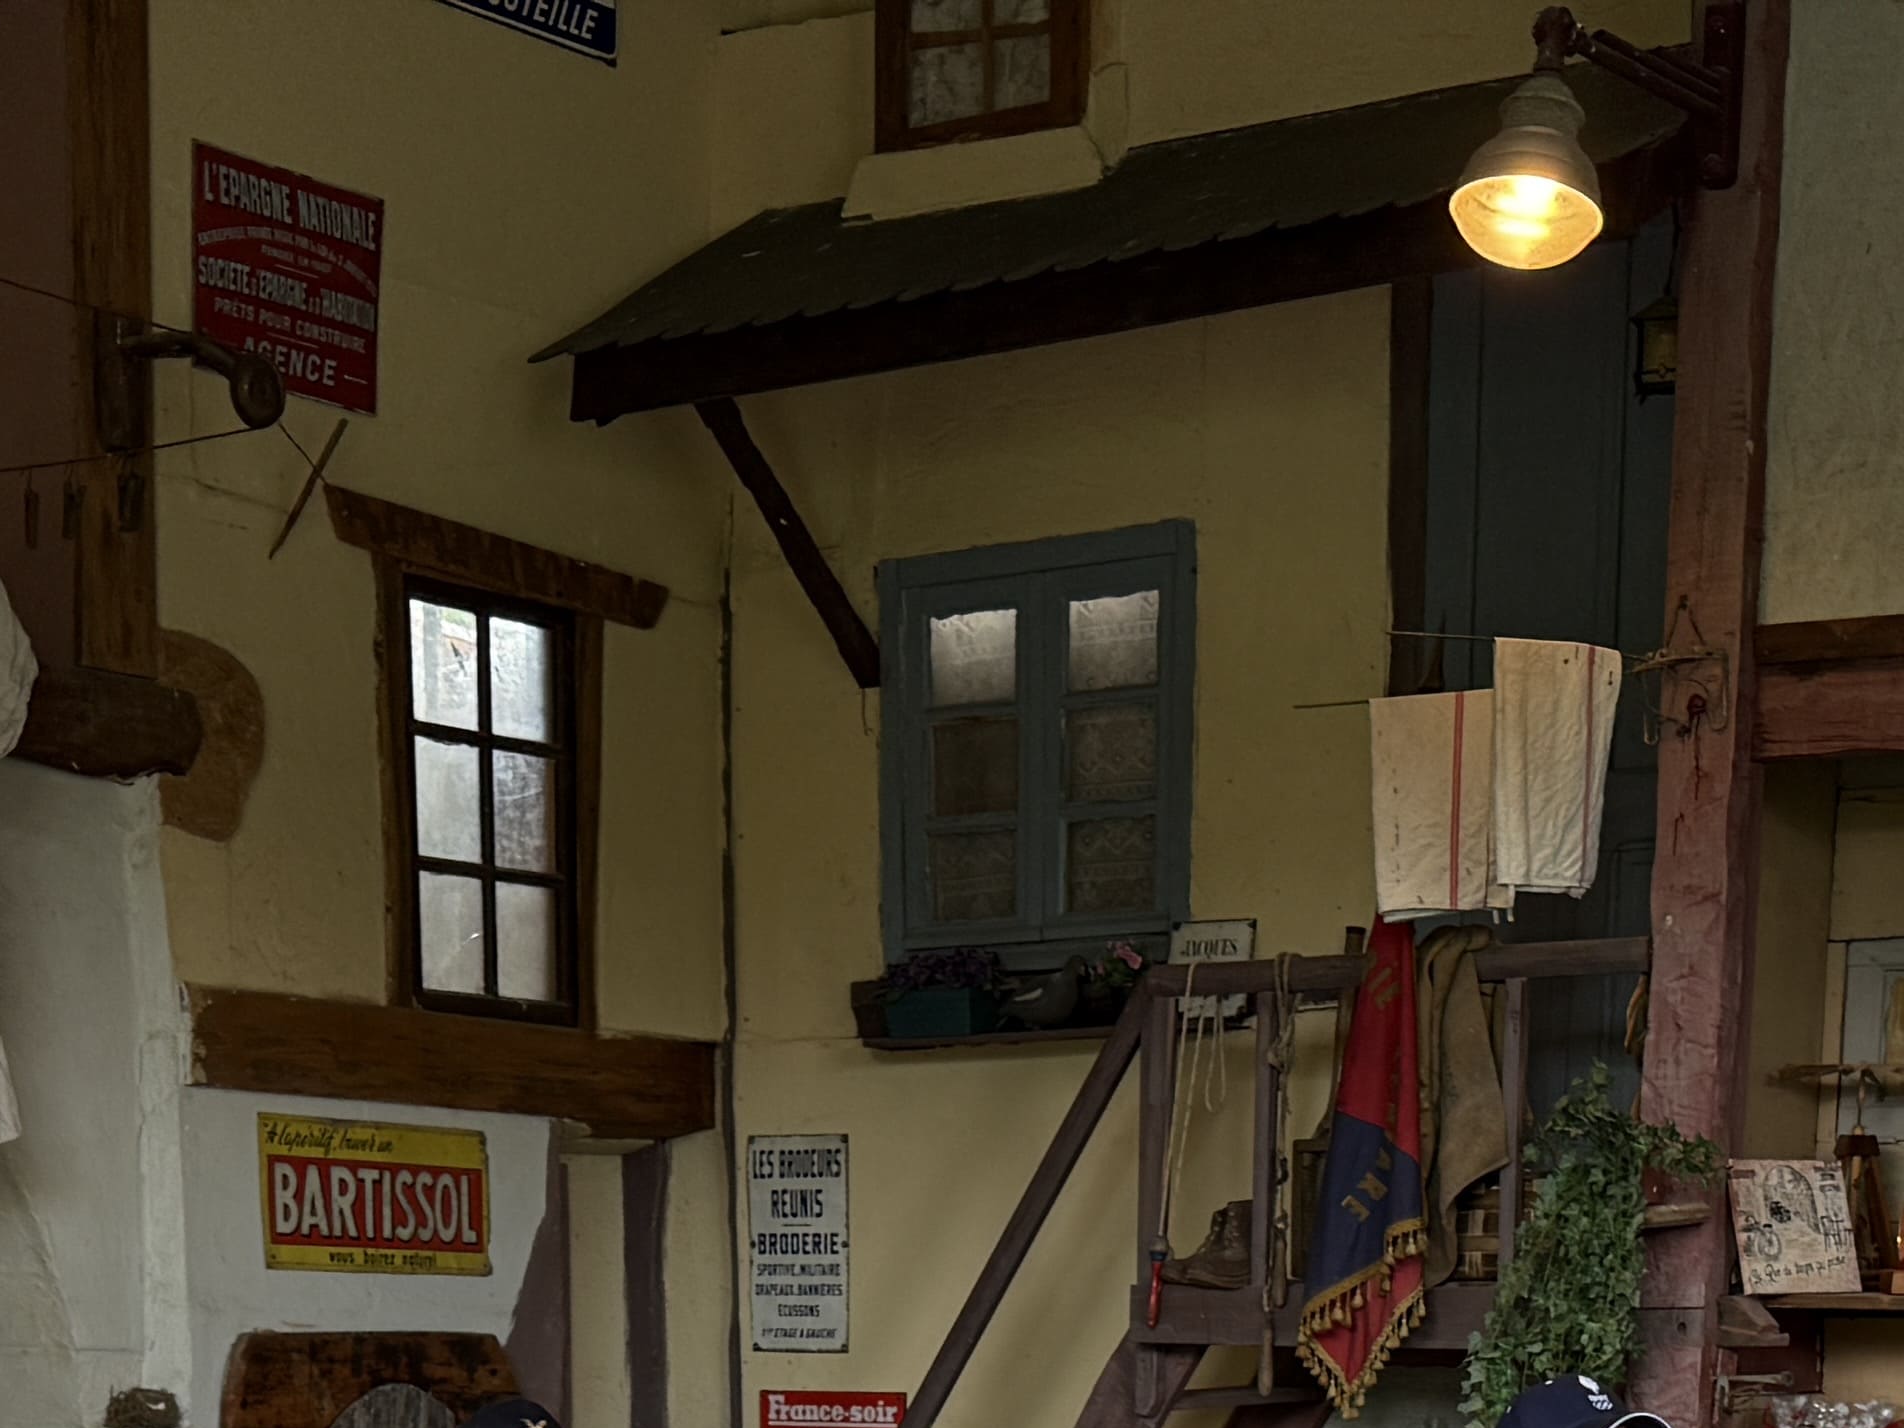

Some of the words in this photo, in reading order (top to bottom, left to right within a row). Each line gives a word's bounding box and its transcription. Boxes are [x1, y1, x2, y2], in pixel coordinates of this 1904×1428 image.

[297, 189, 376, 250] NATIONALE
[752, 1149, 775, 1180] LES
[273, 1162, 479, 1244] BARTISSOL
[756, 1232, 841, 1256] BRODERIE
[767, 1393, 899, 1423] France-soir
